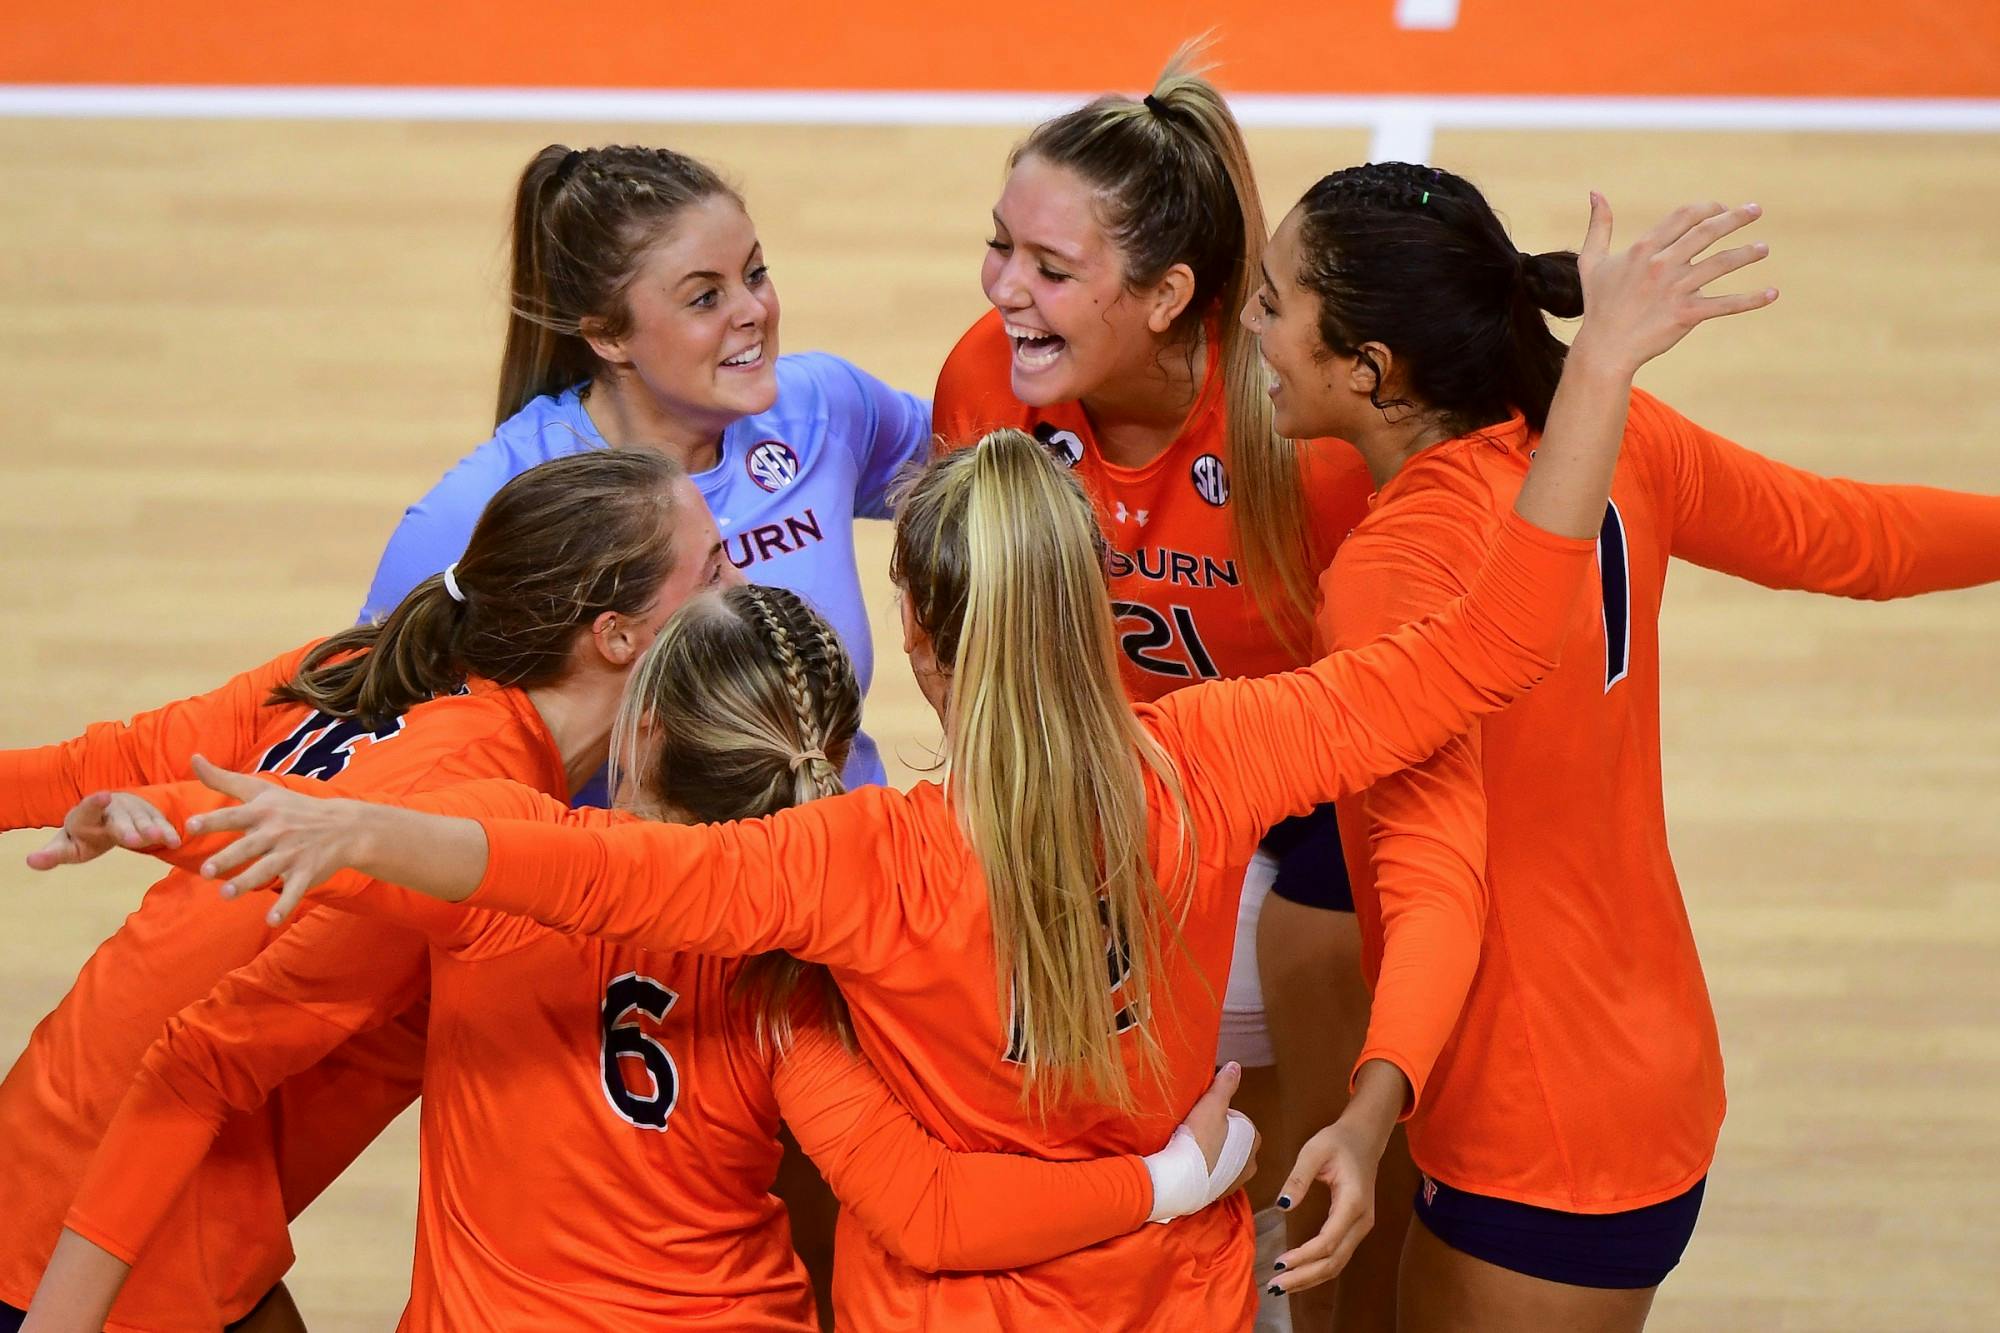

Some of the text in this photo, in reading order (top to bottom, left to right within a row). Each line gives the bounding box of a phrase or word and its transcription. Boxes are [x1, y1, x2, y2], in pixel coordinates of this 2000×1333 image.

[750, 443, 796, 490] SEC
[1193, 455, 1229, 505] SEC
[1110, 600, 1221, 679] 21
[600, 970, 680, 1133] 6
